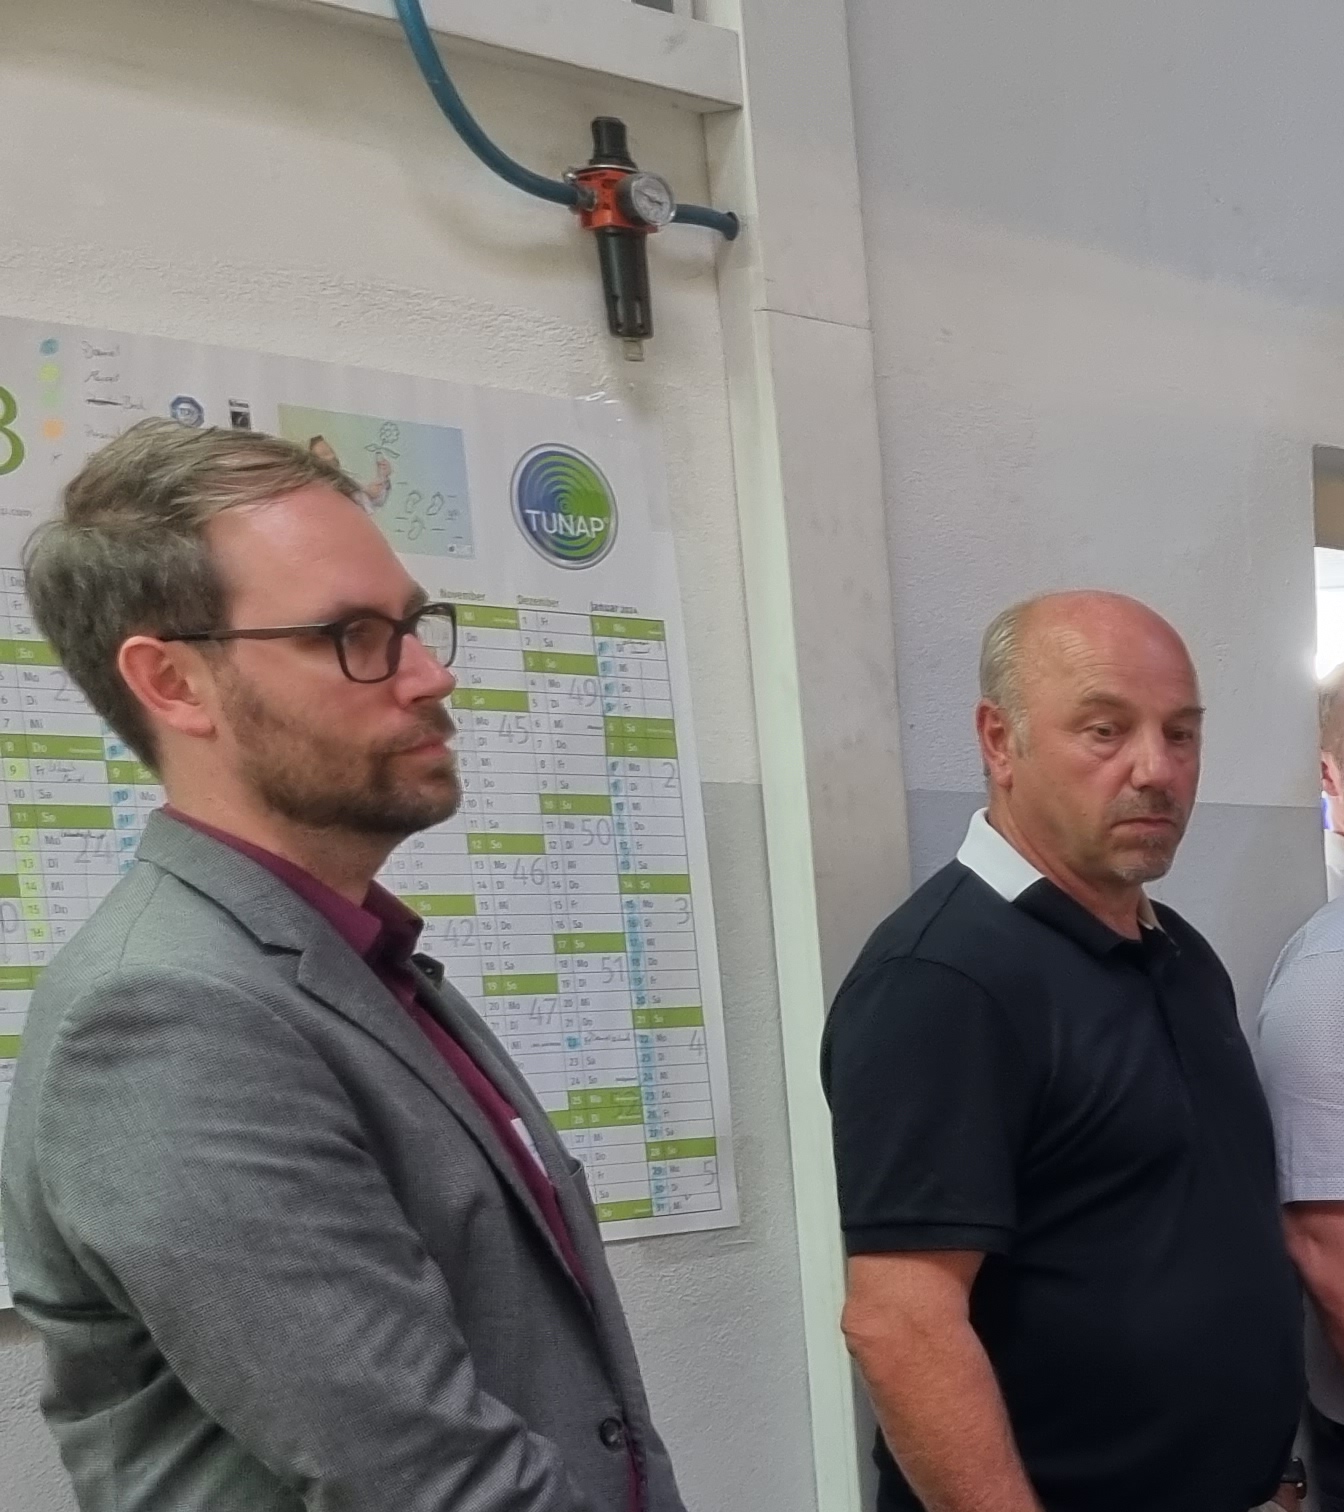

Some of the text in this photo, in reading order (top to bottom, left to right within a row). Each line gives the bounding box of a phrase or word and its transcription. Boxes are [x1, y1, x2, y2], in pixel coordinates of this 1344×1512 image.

[525, 509, 604, 538] TUNAP
[440, 588, 485, 600] November
[517, 595, 559, 607] Dezember
[591, 601, 619, 612] Januar
[24, 672, 39, 682] Mo
[569, 678, 597, 707] 49
[30, 719, 43, 728] Mi
[499, 714, 530, 744] 45
[581, 818, 611, 846] 50
[512, 857, 545, 885] 46
[444, 919, 475, 947] 42
[601, 956, 624, 984] 51
[529, 997, 558, 1025] 47
